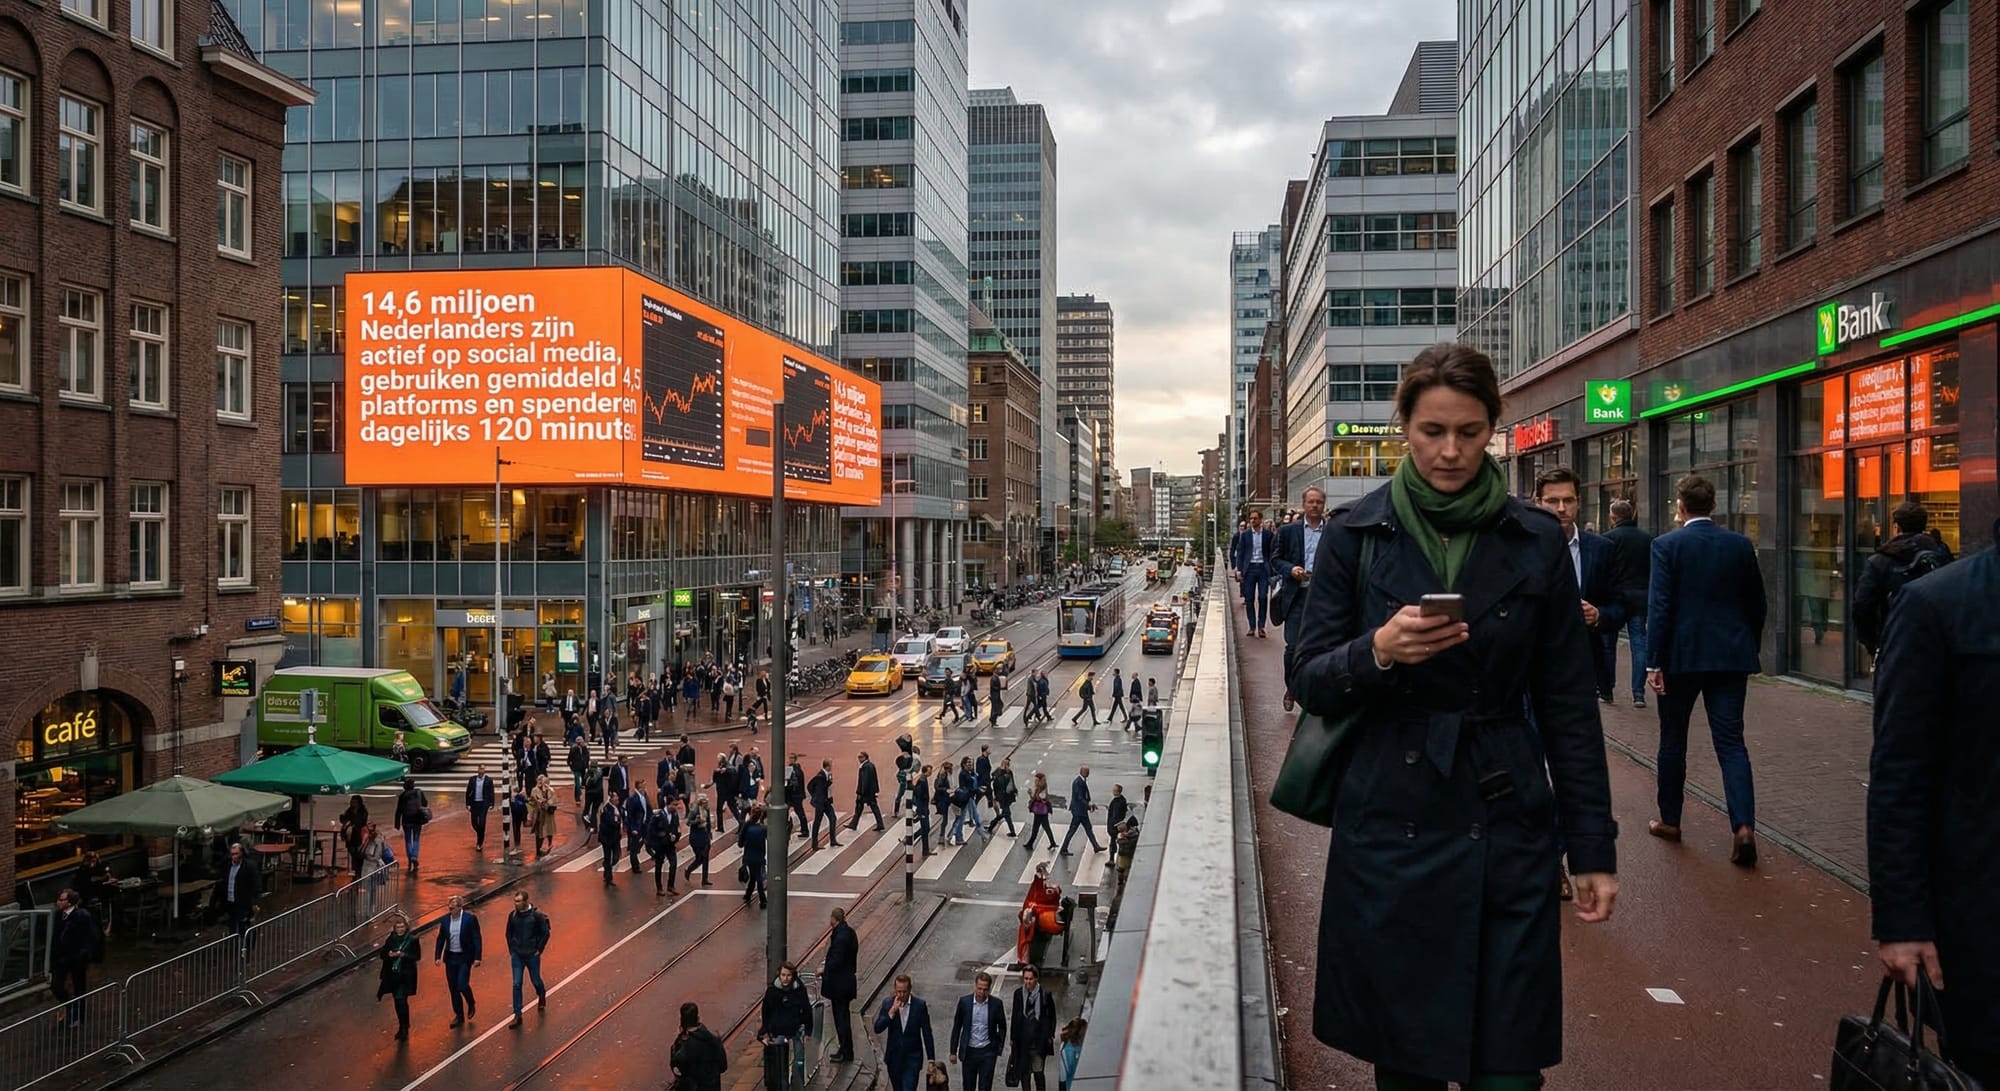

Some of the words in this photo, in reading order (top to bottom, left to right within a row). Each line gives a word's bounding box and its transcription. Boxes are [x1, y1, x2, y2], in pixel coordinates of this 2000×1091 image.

[362, 290, 421, 320] 14,6
[430, 288, 535, 316] miljoen
[1838, 292, 1888, 344] Bank
[360, 317, 524, 341] Nederlanders
[530, 315, 575, 343] zijn
[360, 343, 427, 366] actief
[431, 347, 461, 370] op
[467, 342, 536, 365] social
[543, 340, 623, 366] media,
[360, 367, 480, 396] gebruiken
[487, 364, 616, 395] gemiddeld
[622, 365, 641, 393] 4,5
[361, 393, 478, 422] platforms
[484, 397, 515, 416] en
[521, 391, 637, 420] spenderen
[1593, 407, 1624, 419] Bank
[360, 417, 471, 447] dagelijks
[479, 415, 532, 441] 120
[44, 710, 96, 745] café
